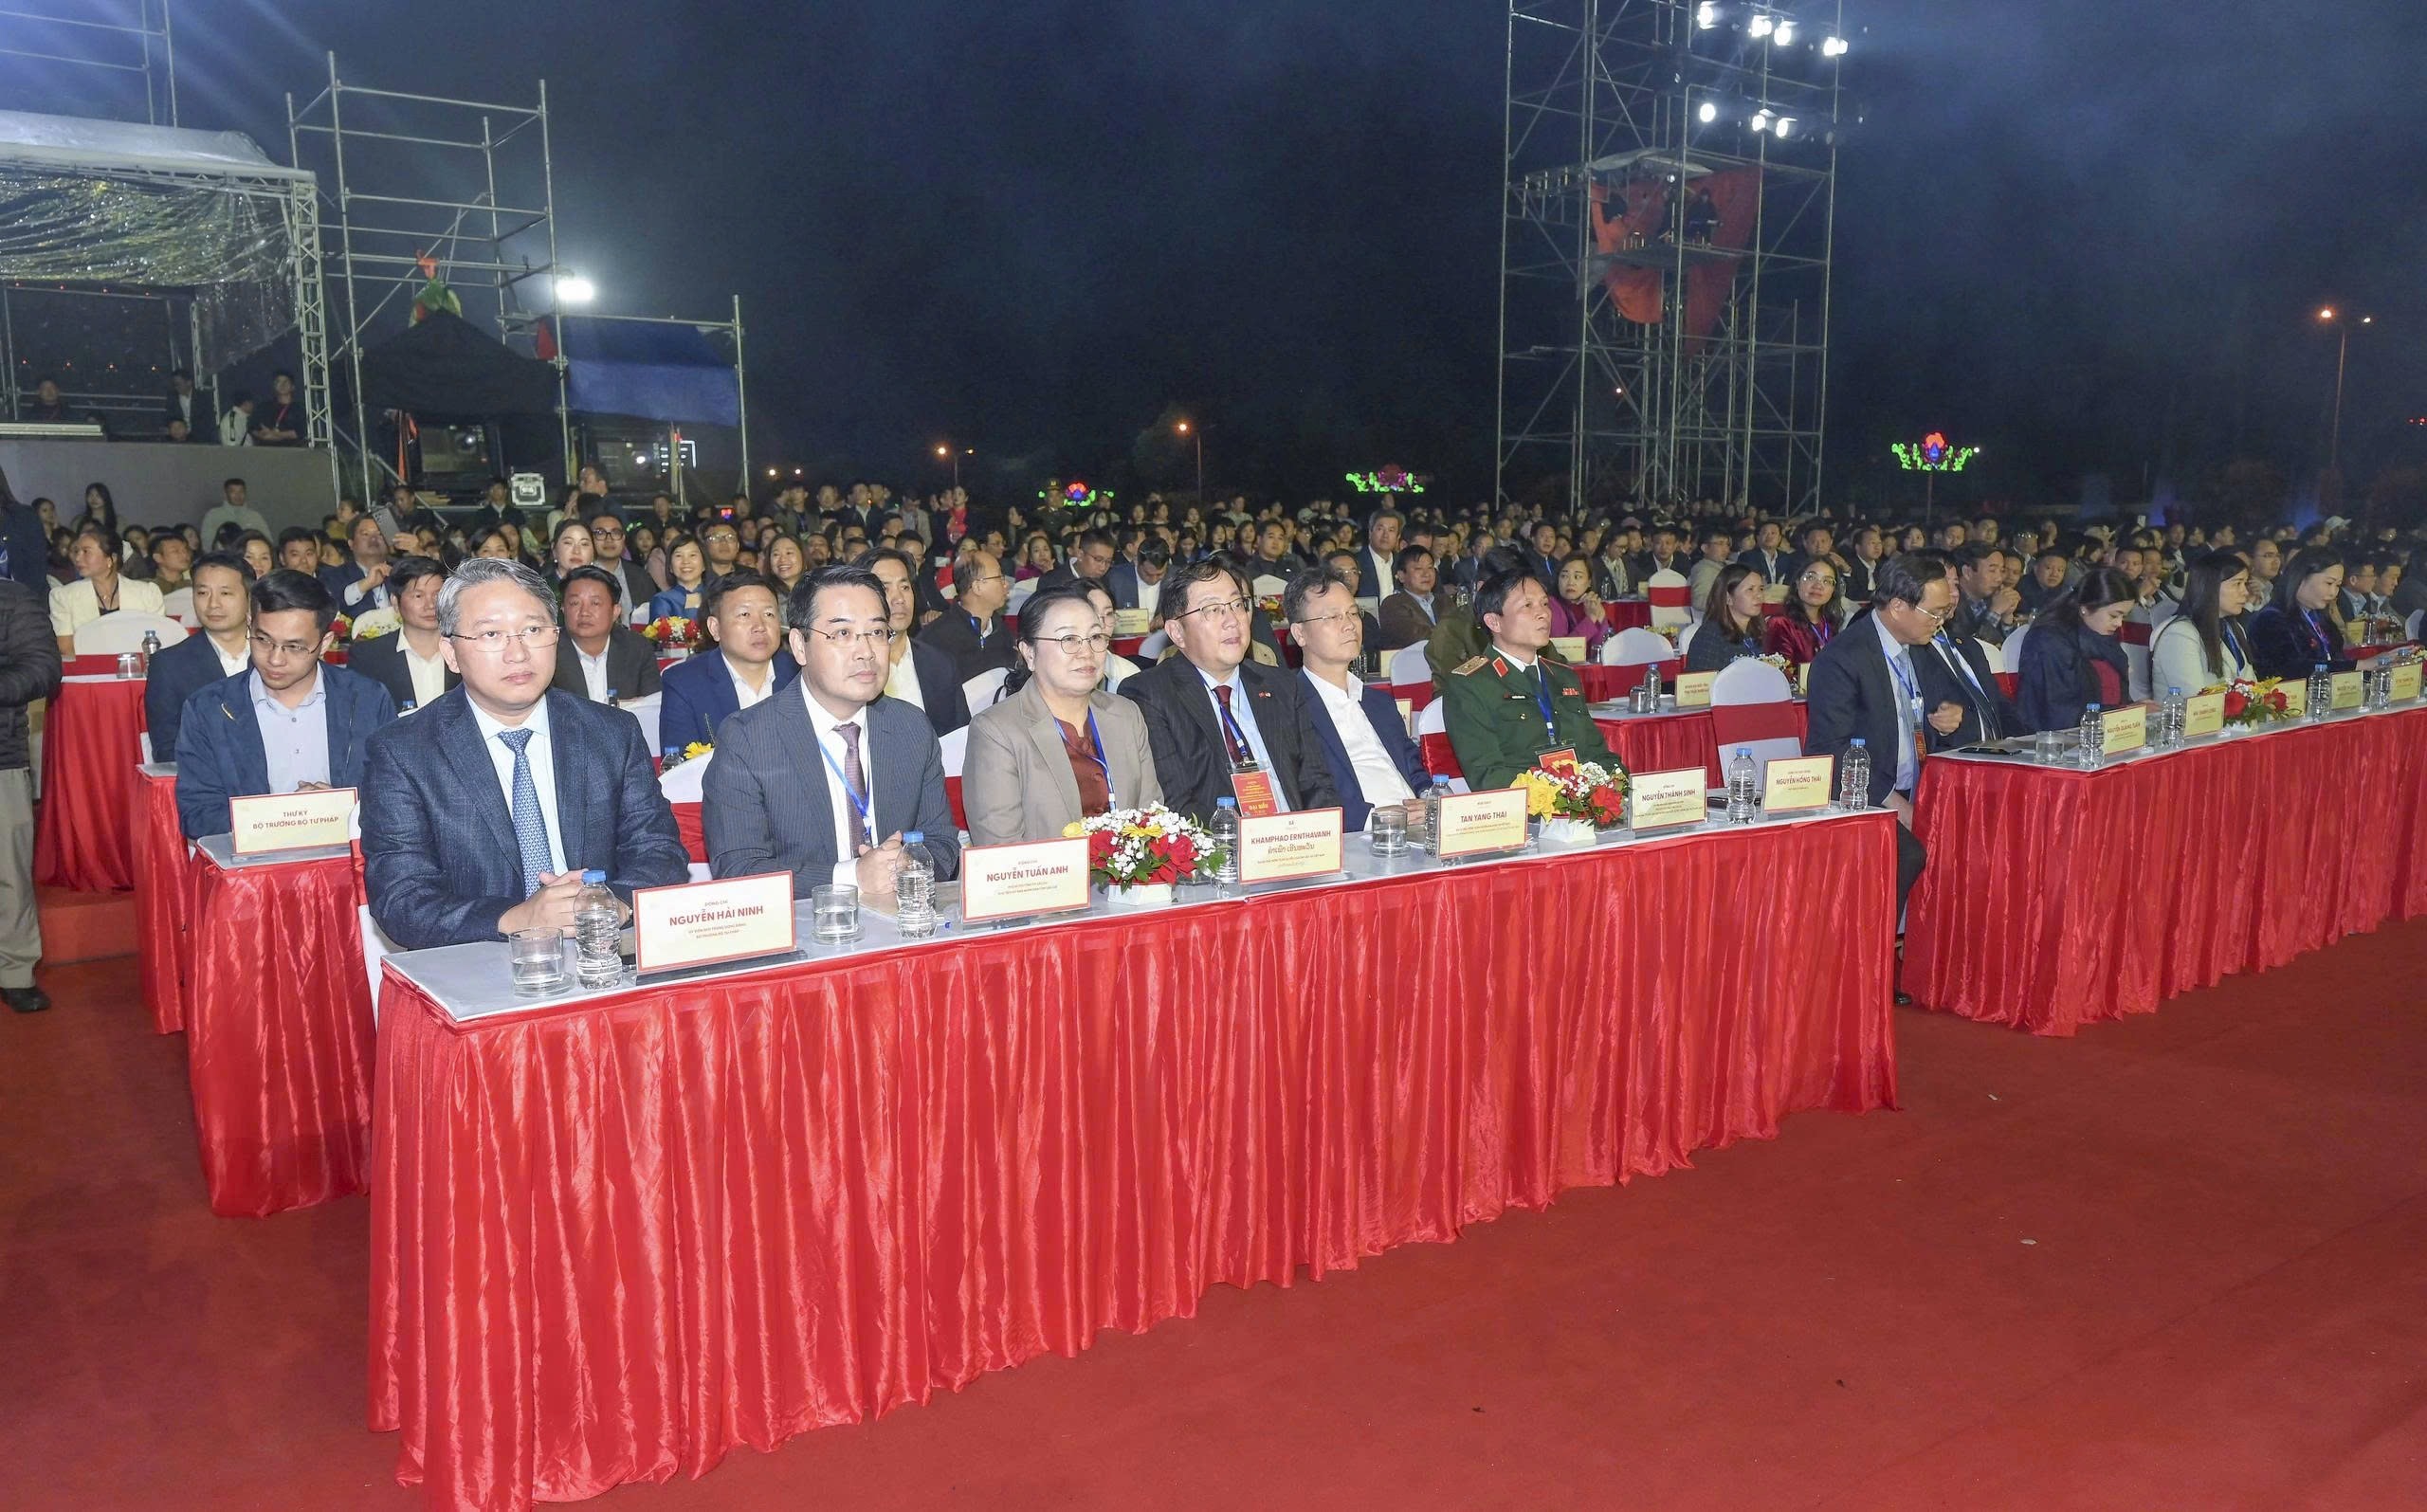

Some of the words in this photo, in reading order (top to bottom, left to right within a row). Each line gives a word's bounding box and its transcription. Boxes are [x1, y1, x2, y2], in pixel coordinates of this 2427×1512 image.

[1473, 812, 1492, 821] YANG
[1250, 834, 1289, 845] KHAMPHAO
[1289, 830, 1331, 841] ERNTHAVANH
[986, 867, 1024, 883] NGUYỄN
[1025, 865, 1049, 878] TUẤN
[1049, 865, 1068, 875] ANH
[669, 908, 715, 926] NGUYỄN
[717, 906, 736, 920] HẢI
[738, 905, 764, 917] NINH
